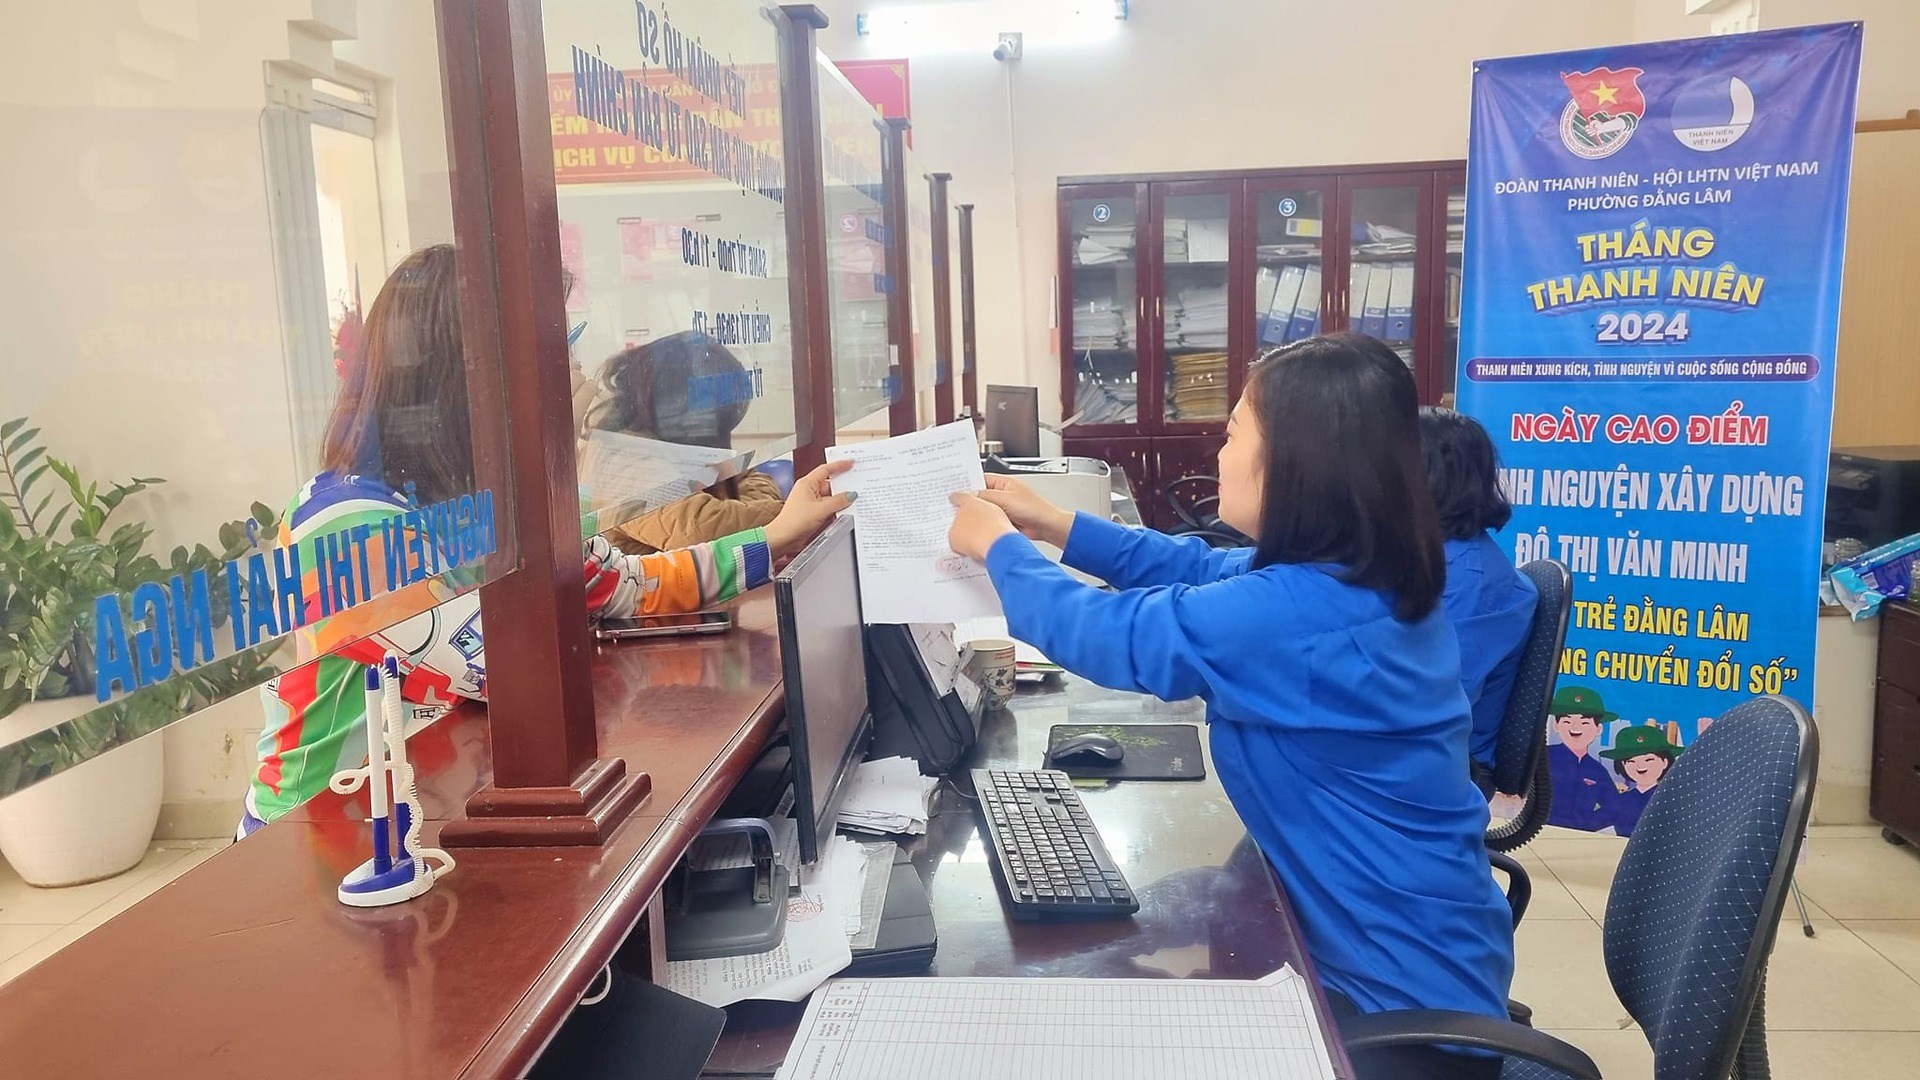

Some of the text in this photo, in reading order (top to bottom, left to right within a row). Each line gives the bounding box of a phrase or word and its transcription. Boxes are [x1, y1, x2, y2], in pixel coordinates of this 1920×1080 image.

[551, 109, 589, 135] ỂM
[554, 146, 597, 171] ỊCH
[603, 145, 636, 169] VỤ
[1495, 175, 1539, 195] ĐOÀN
[1543, 176, 1597, 193] THANH
[1601, 171, 1639, 189] NIÊN
[1653, 167, 1683, 187] HỘI
[1687, 167, 1731, 184] LHTN
[1735, 161, 1771, 182] VIỆT
[1775, 161, 1819, 178] NAM
[1568, 187, 1731, 211] PHƯỜNG ĐẰNG LÂM
[1577, 219, 1715, 262] THÁNG
[1527, 262, 1764, 310] THANH NIÊN
[1597, 313, 1688, 342] 2024
[1476, 359, 1807, 378] THANH NIÊN XUNG KÍCH, TÌNH NGUYỆN VÌ CUỘC SỐNG CỘNG ĐỒNG
[1511, 400, 1769, 445] NGÀY CAO ĐIỂM
[1499, 464, 1803, 523] NH NGUYỆN XÂY DỰNG
[1558, 534, 1599, 582] THỊ
[1607, 530, 1662, 578] VĂN
[1669, 541, 1748, 583] MINH
[1574, 595, 1749, 642] TRẺ ĐẰNG LÂM
[1558, 648, 1587, 676] NG
[1594, 644, 1689, 687] CHUYỂN
[1697, 649, 1740, 692] ĐỔI
